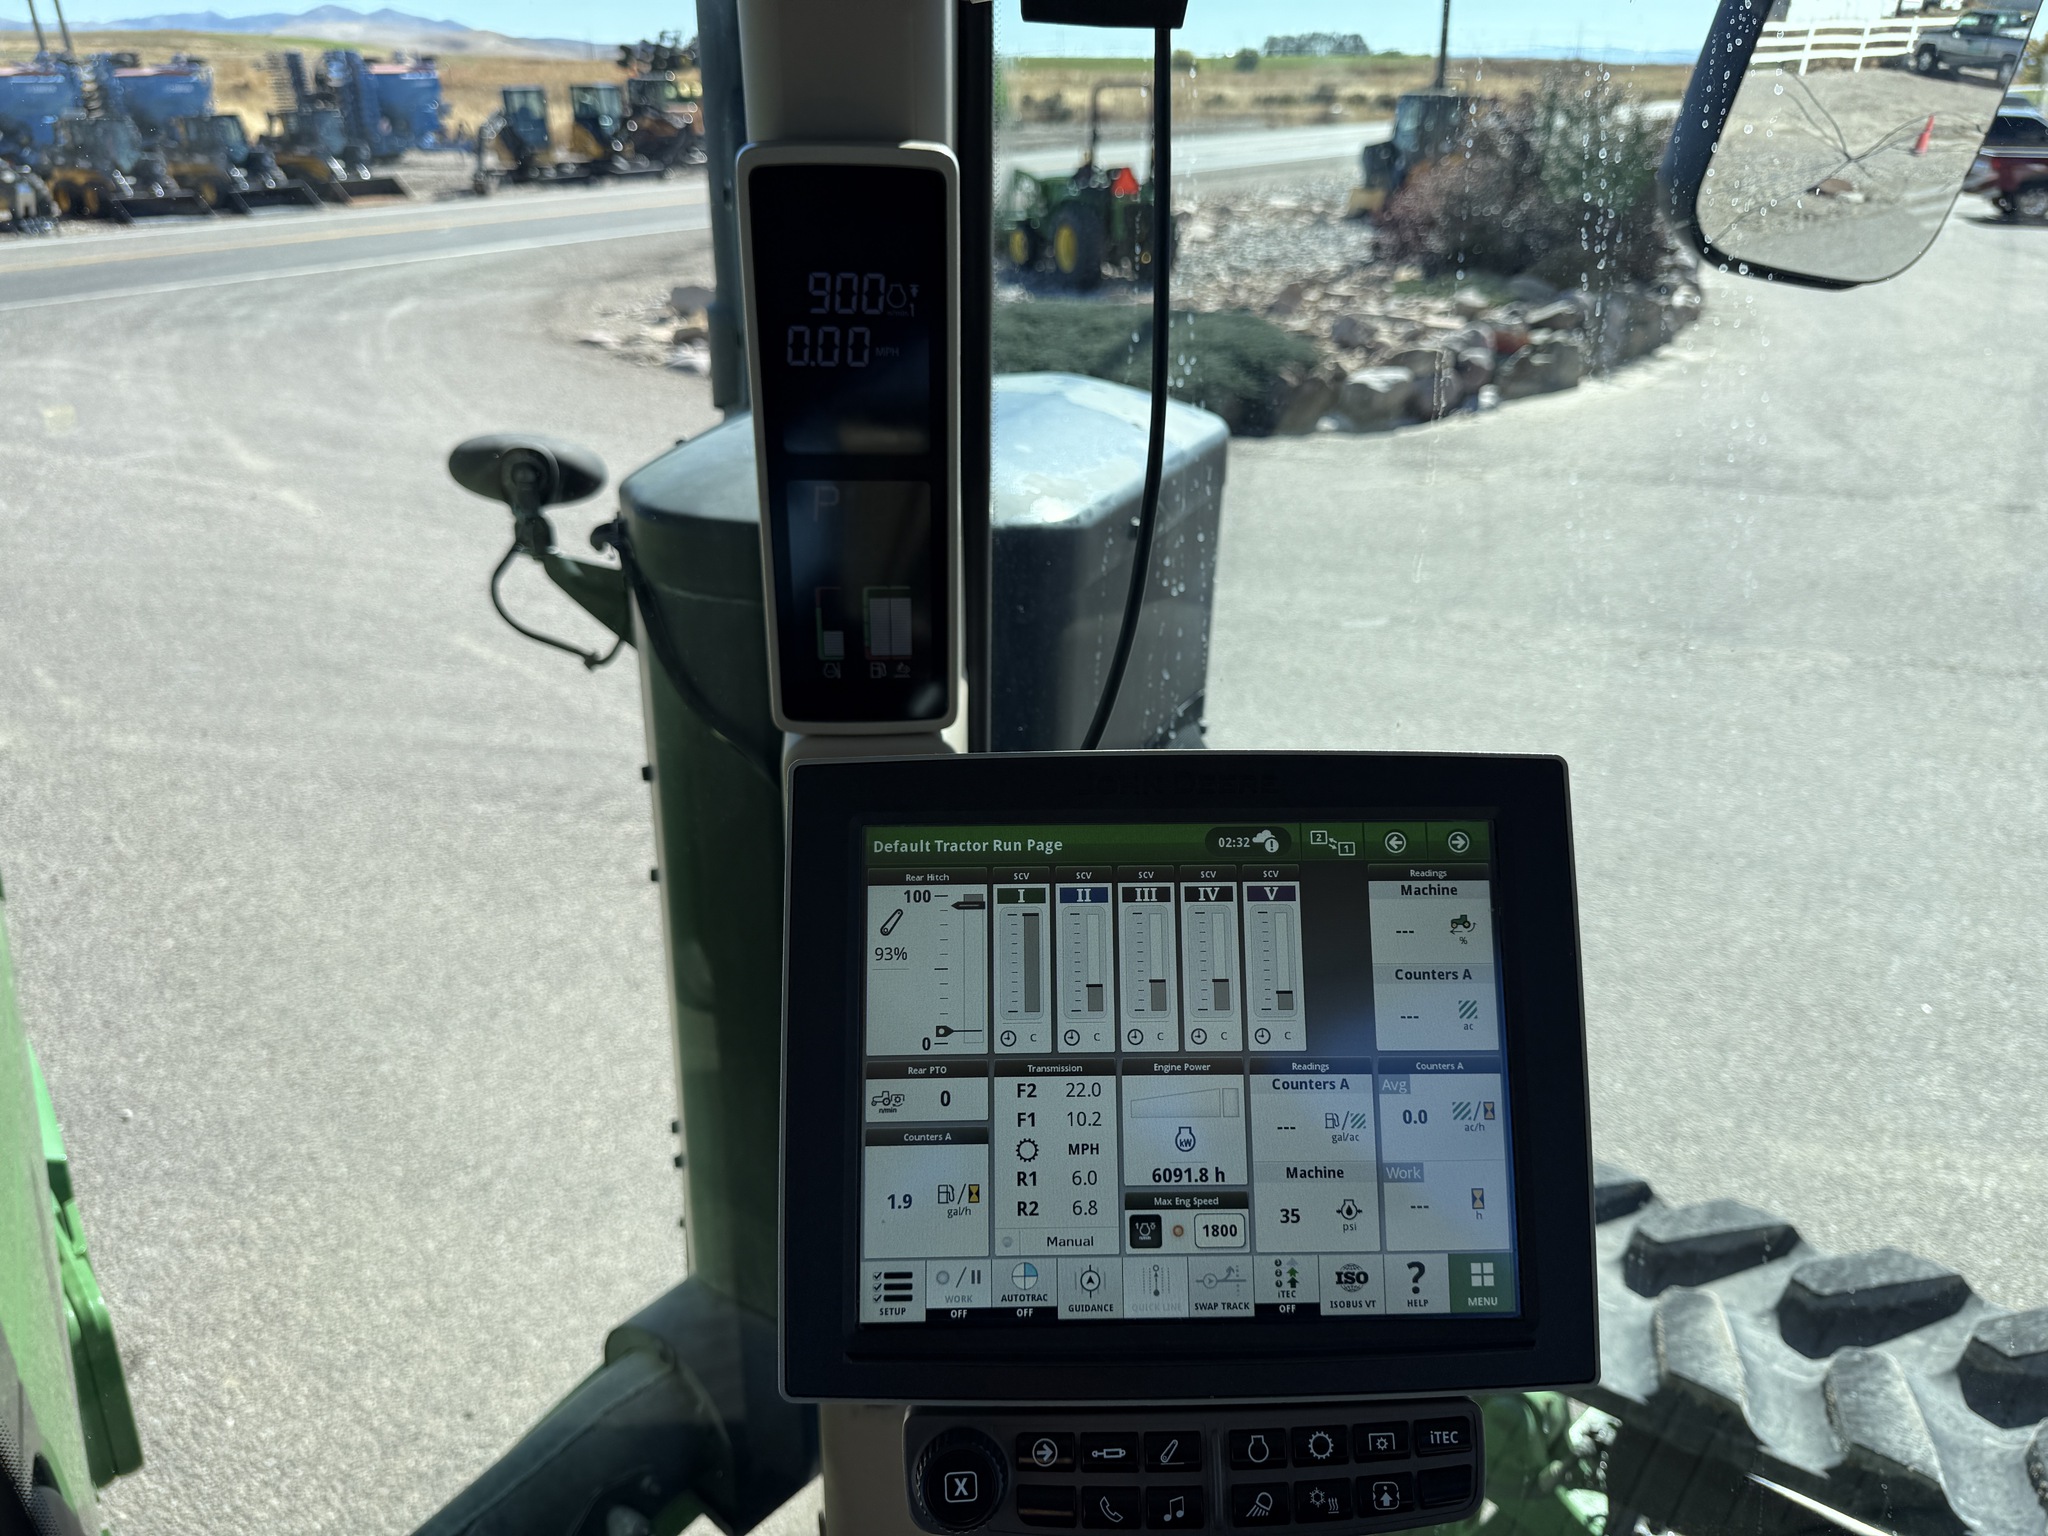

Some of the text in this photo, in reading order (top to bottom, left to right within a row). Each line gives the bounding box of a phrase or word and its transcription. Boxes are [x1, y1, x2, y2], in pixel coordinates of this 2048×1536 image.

[808, 272, 885, 314] 900
[787, 325, 899, 367] 0.00 MPH
[813, 485, 840, 522] P
[873, 839, 1063, 855] Default Tractor Run Page
[1218, 837, 1250, 848] 02:32
[905, 873, 950, 882] Rear Hitch
[1013, 872, 1030, 881] SCV
[1075, 871, 1092, 880] SCV
[1138, 871, 1154, 879] SCV
[1200, 870, 1217, 879] SCV
[1262, 869, 1279, 878] SCV
[1410, 869, 1448, 879] Readings
[1076, 888, 1092, 902] II
[1135, 887, 1158, 902] III
[1198, 887, 1220, 901] IV
[1263, 886, 1279, 901] V
[1400, 884, 1458, 896] Machine
[903, 889, 932, 903] 100
[874, 947, 908, 962] 93%
[1394, 968, 1472, 981] Counters A
[1463, 1022, 1474, 1031] ac
[1030, 1033, 1037, 1043] C
[1093, 1032, 1100, 1042] C
[1157, 1032, 1164, 1041] C
[1220, 1031, 1228, 1041] C
[1284, 1031, 1292, 1040] C
[922, 1037, 931, 1051] 0
[908, 1066, 947, 1075] Rear PTO
[1027, 1063, 1083, 1073] Transmission
[1153, 1063, 1211, 1073] Engine Power
[1291, 1062, 1330, 1073] Readings
[1416, 1062, 1464, 1070] Counters A
[1016, 1082, 1101, 1098] F2 22.0
[1272, 1079, 1350, 1091] Counters A
[1382, 1078, 1408, 1094] Avg
[940, 1090, 951, 1107] 0
[1017, 1111, 1102, 1128] F1 10.2
[1402, 1109, 1428, 1125] 0.0
[1464, 1122, 1485, 1133] ac/h
[903, 1133, 952, 1141] Counters A
[1331, 1132, 1360, 1143] gal/ac
[1179, 1138, 1193, 1148] kW
[1068, 1143, 1100, 1156] MPH
[1152, 1166, 1225, 1183] 6091.8 h
[1286, 1166, 1344, 1179] Machine
[1386, 1166, 1422, 1179] Work
[1016, 1170, 1098, 1187] R1 6.0
[887, 1193, 913, 1209] 1.9
[1154, 1196, 1219, 1207] Max Eng Speed
[947, 1207, 972, 1219] gal/h
[1017, 1200, 1098, 1216] R2 6.8
[1280, 1208, 1301, 1224] 35
[1476, 1210, 1482, 1220] h
[1202, 1224, 1238, 1237] 1800
[1342, 1222, 1357, 1233] psi
[1047, 1236, 1094, 1248] Manual
[1335, 1271, 1369, 1286] ISO
[944, 1295, 973, 1304] WORK
[1001, 1293, 1048, 1303] AUTOTRAC
[1277, 1289, 1296, 1299] iTEC
[1194, 1301, 1250, 1311] SWAP TRACK
[1330, 1299, 1376, 1309] ISOBUS VT
[1407, 1299, 1429, 1308] HELP
[1468, 1297, 1498, 1306] MENU
[879, 1307, 907, 1316] SETUP
[1016, 1308, 1034, 1318] OFF
[1068, 1303, 1114, 1313] GUIDANCE
[1278, 1304, 1296, 1313] OFF
[950, 1309, 968, 1319] OFF
[1430, 1430, 1459, 1444] iTEC
[954, 1477, 969, 1496] X
